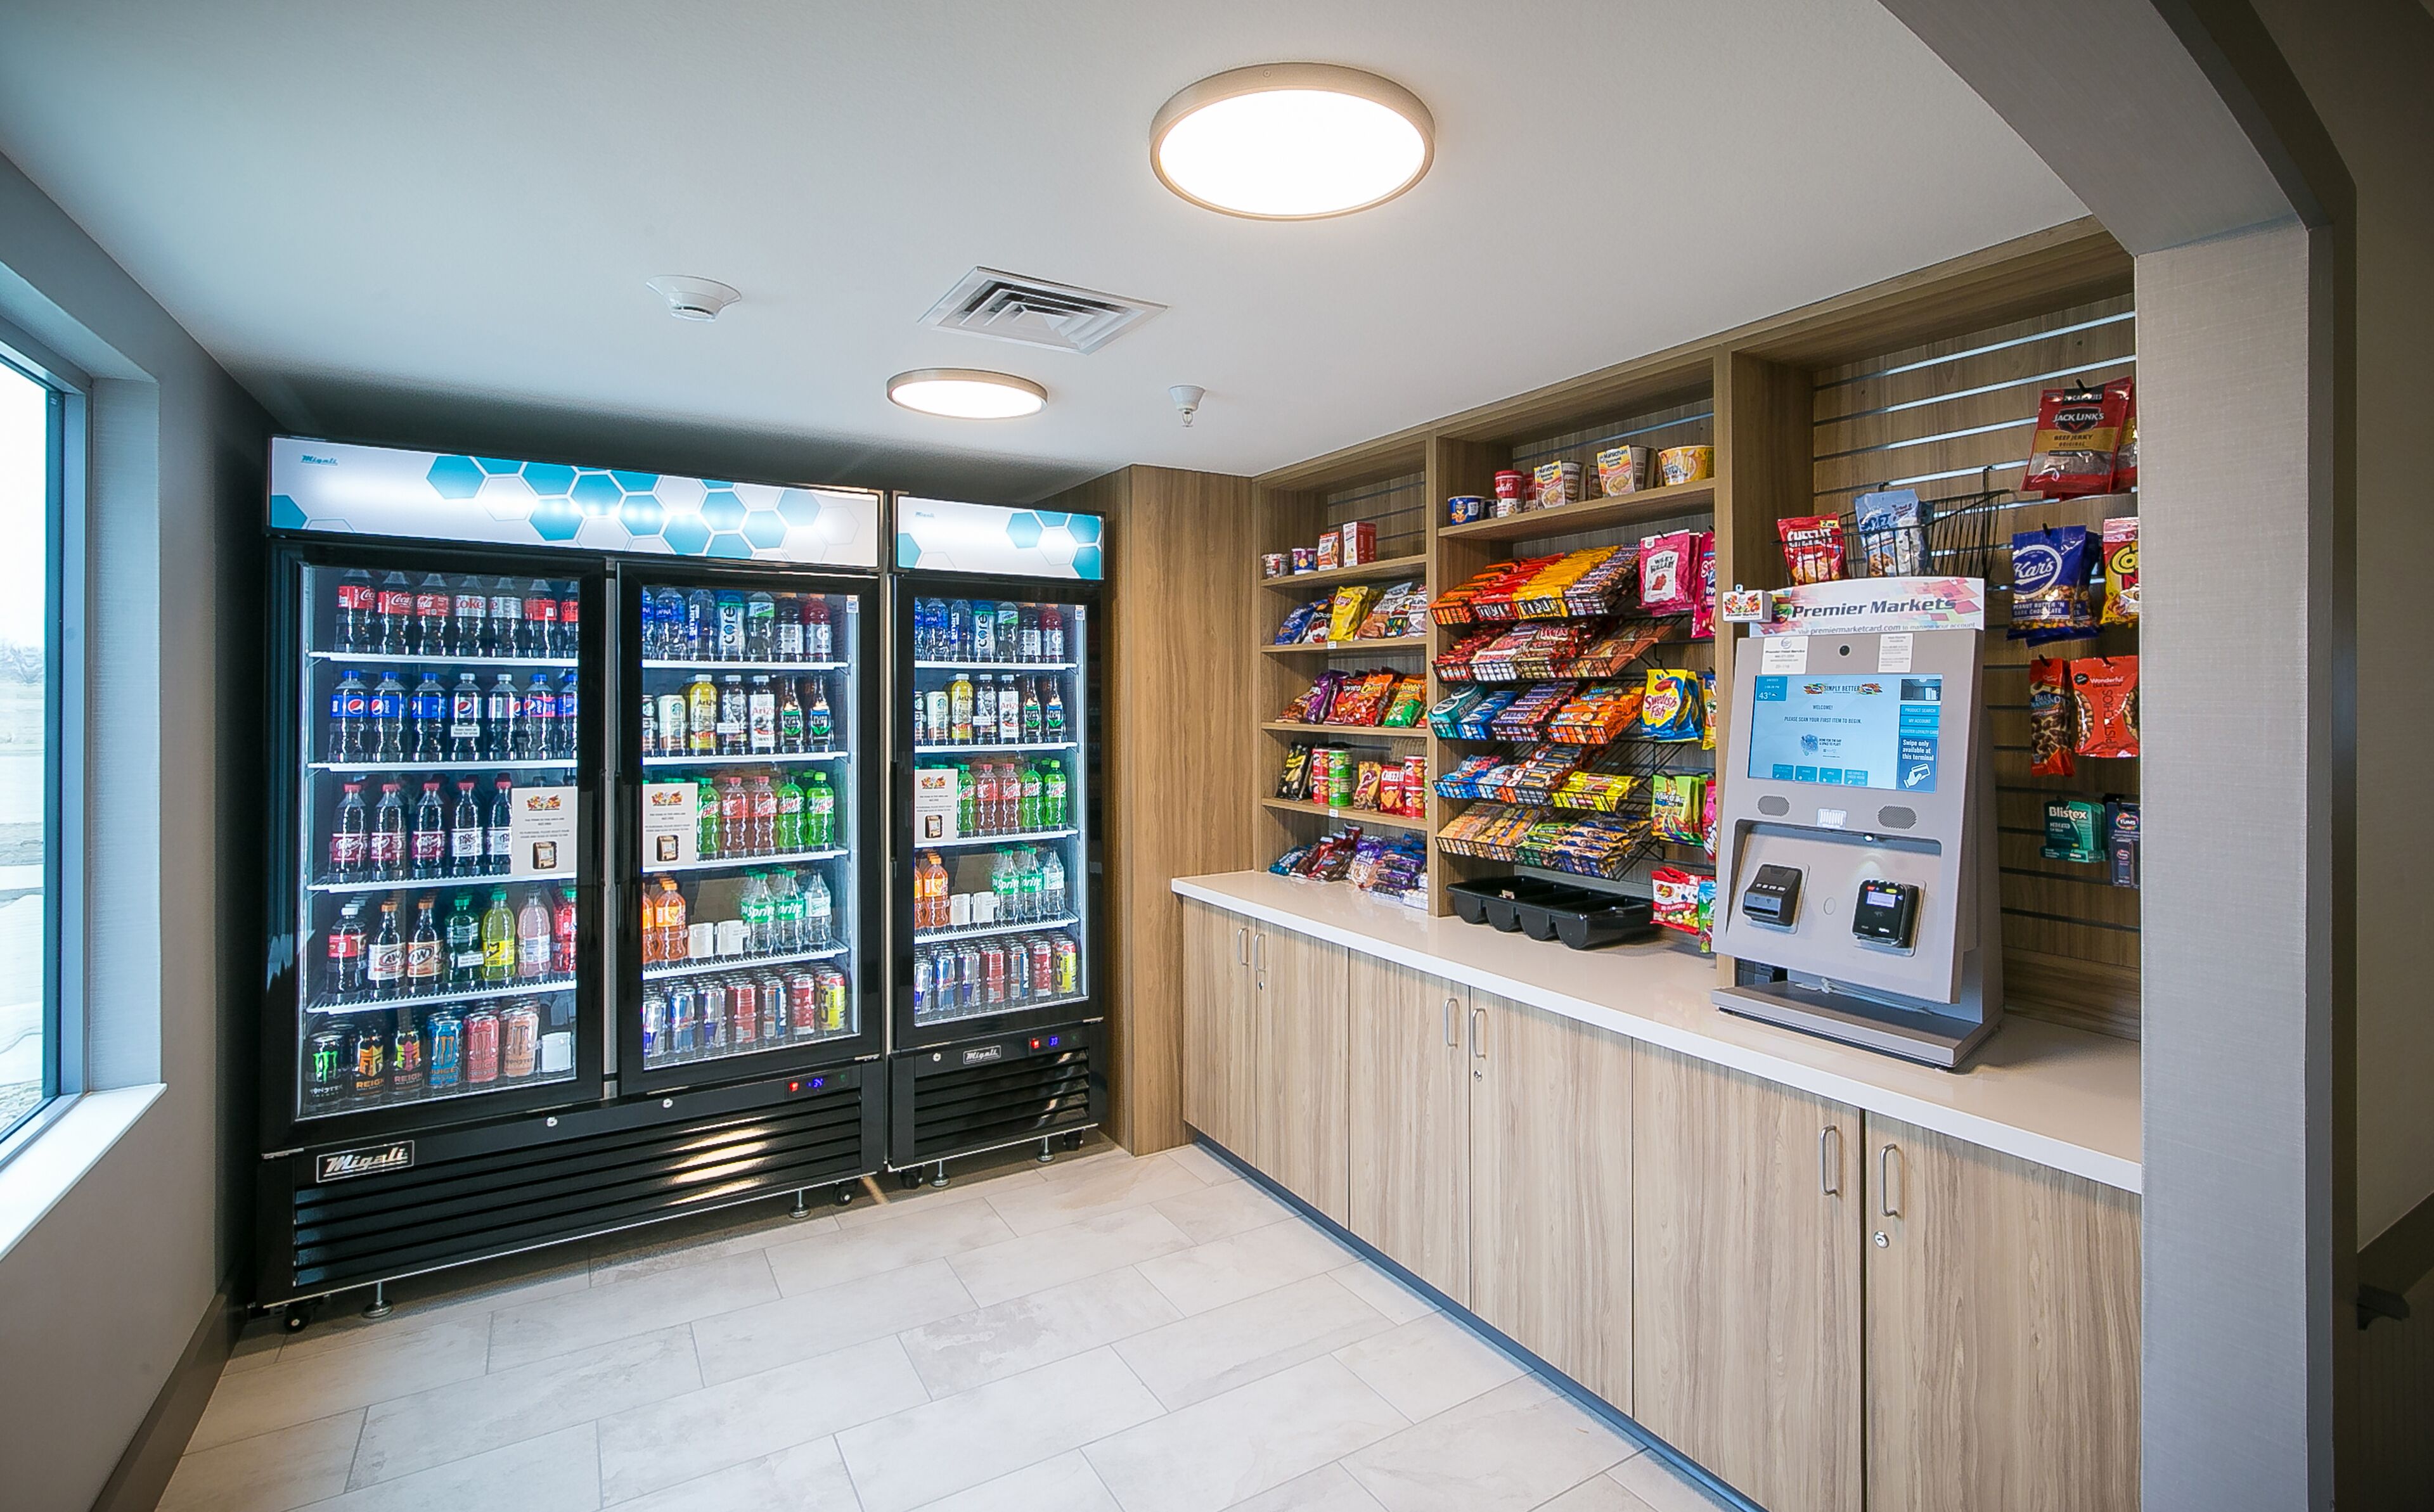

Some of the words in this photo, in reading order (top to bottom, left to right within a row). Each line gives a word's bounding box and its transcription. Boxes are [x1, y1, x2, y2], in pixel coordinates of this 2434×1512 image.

[2053, 413, 2076, 423] JACK
[1604, 449, 1628, 458] Maruchan
[2013, 557, 2056, 578] Kar's
[454, 597, 484, 609] Coke
[1792, 601, 1867, 618] Premier
[1869, 598, 1957, 613] Markets
[723, 605, 736, 644] core
[978, 613, 988, 648] core
[1810, 624, 1900, 636] premiermarketcard.com
[2090, 676, 2124, 684] Wonderful
[1645, 693, 1677, 710] Swedish
[1651, 706, 1666, 719] Fish
[2102, 689, 2116, 745] PISTACHIOS
[2048, 806, 2089, 822] Blistex
[966, 1049, 998, 1061] Migali
[324, 1141, 408, 1177] Migali
